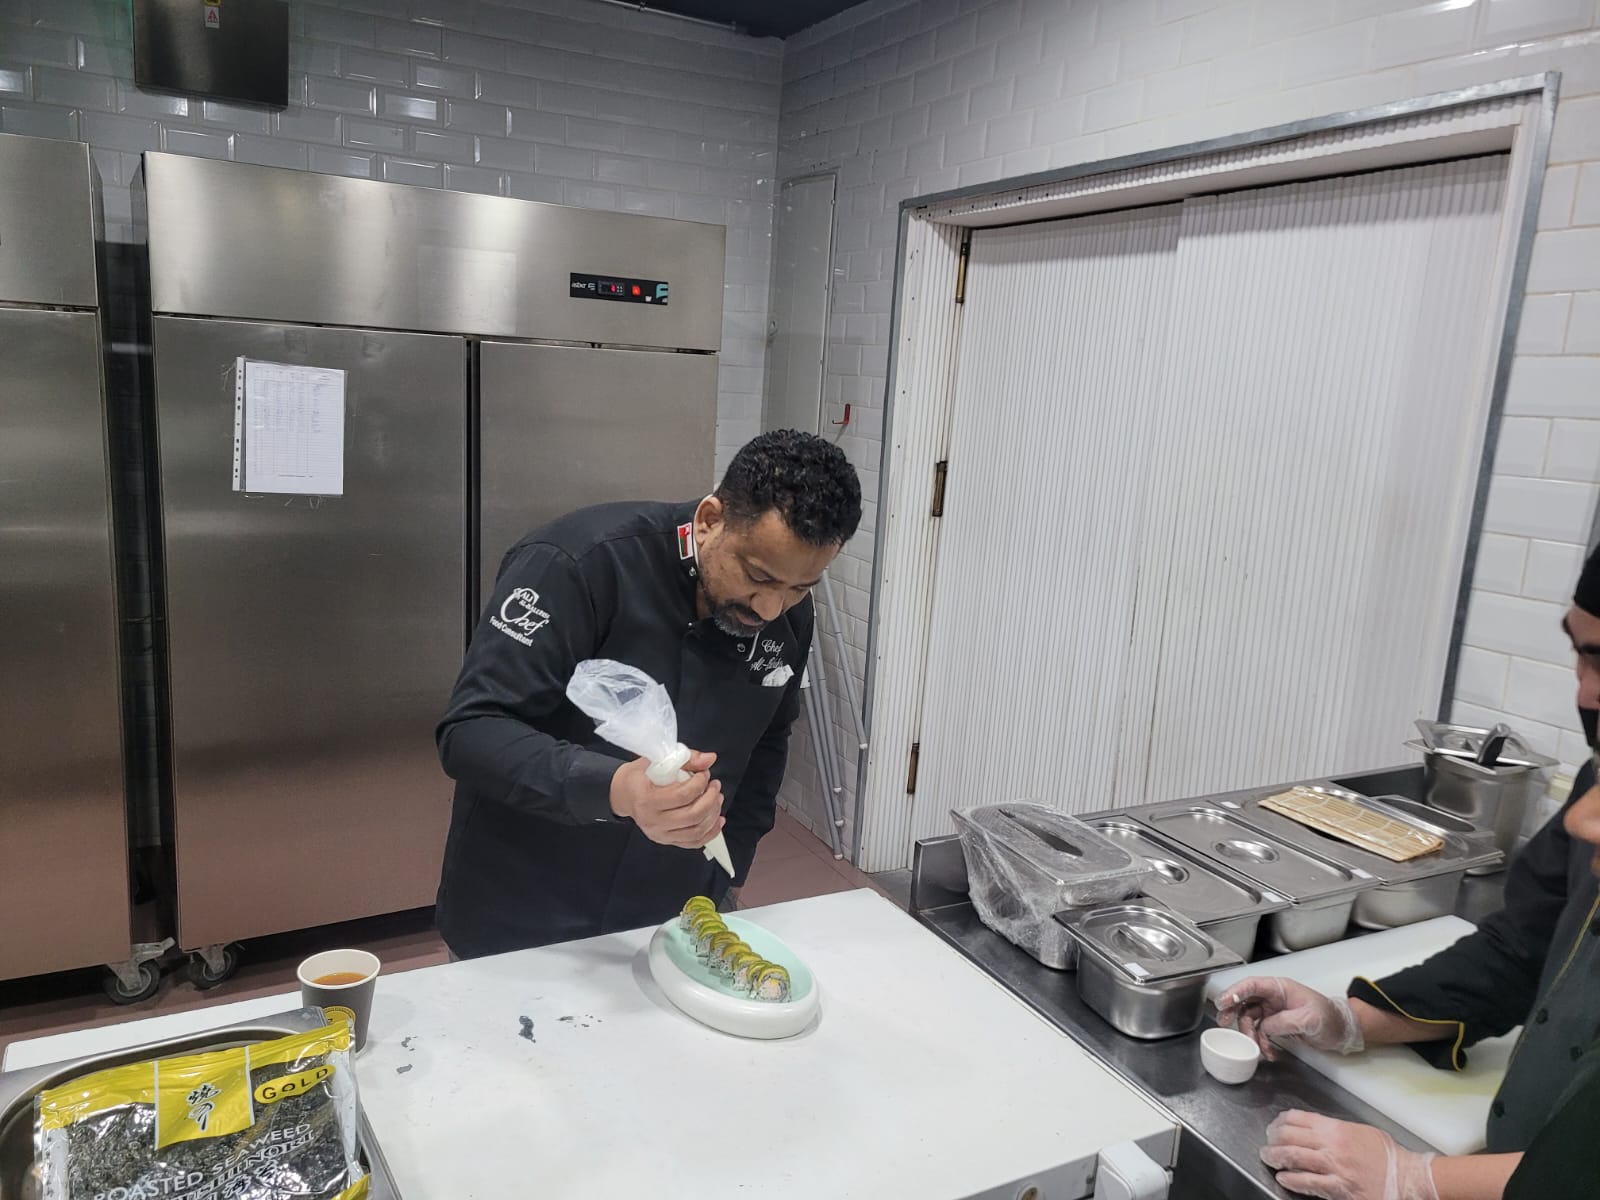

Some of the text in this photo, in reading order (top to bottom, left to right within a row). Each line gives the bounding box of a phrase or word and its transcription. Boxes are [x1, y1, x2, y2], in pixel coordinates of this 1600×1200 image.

[500, 588, 550, 636] Chef
[489, 615, 534, 647] Food Consultant
[761, 639, 785, 657] Chef
[262, 1068, 329, 1100] GOLD
[212, 1123, 311, 1175] SEAWEED
[244, 1129, 315, 1170] NORI
